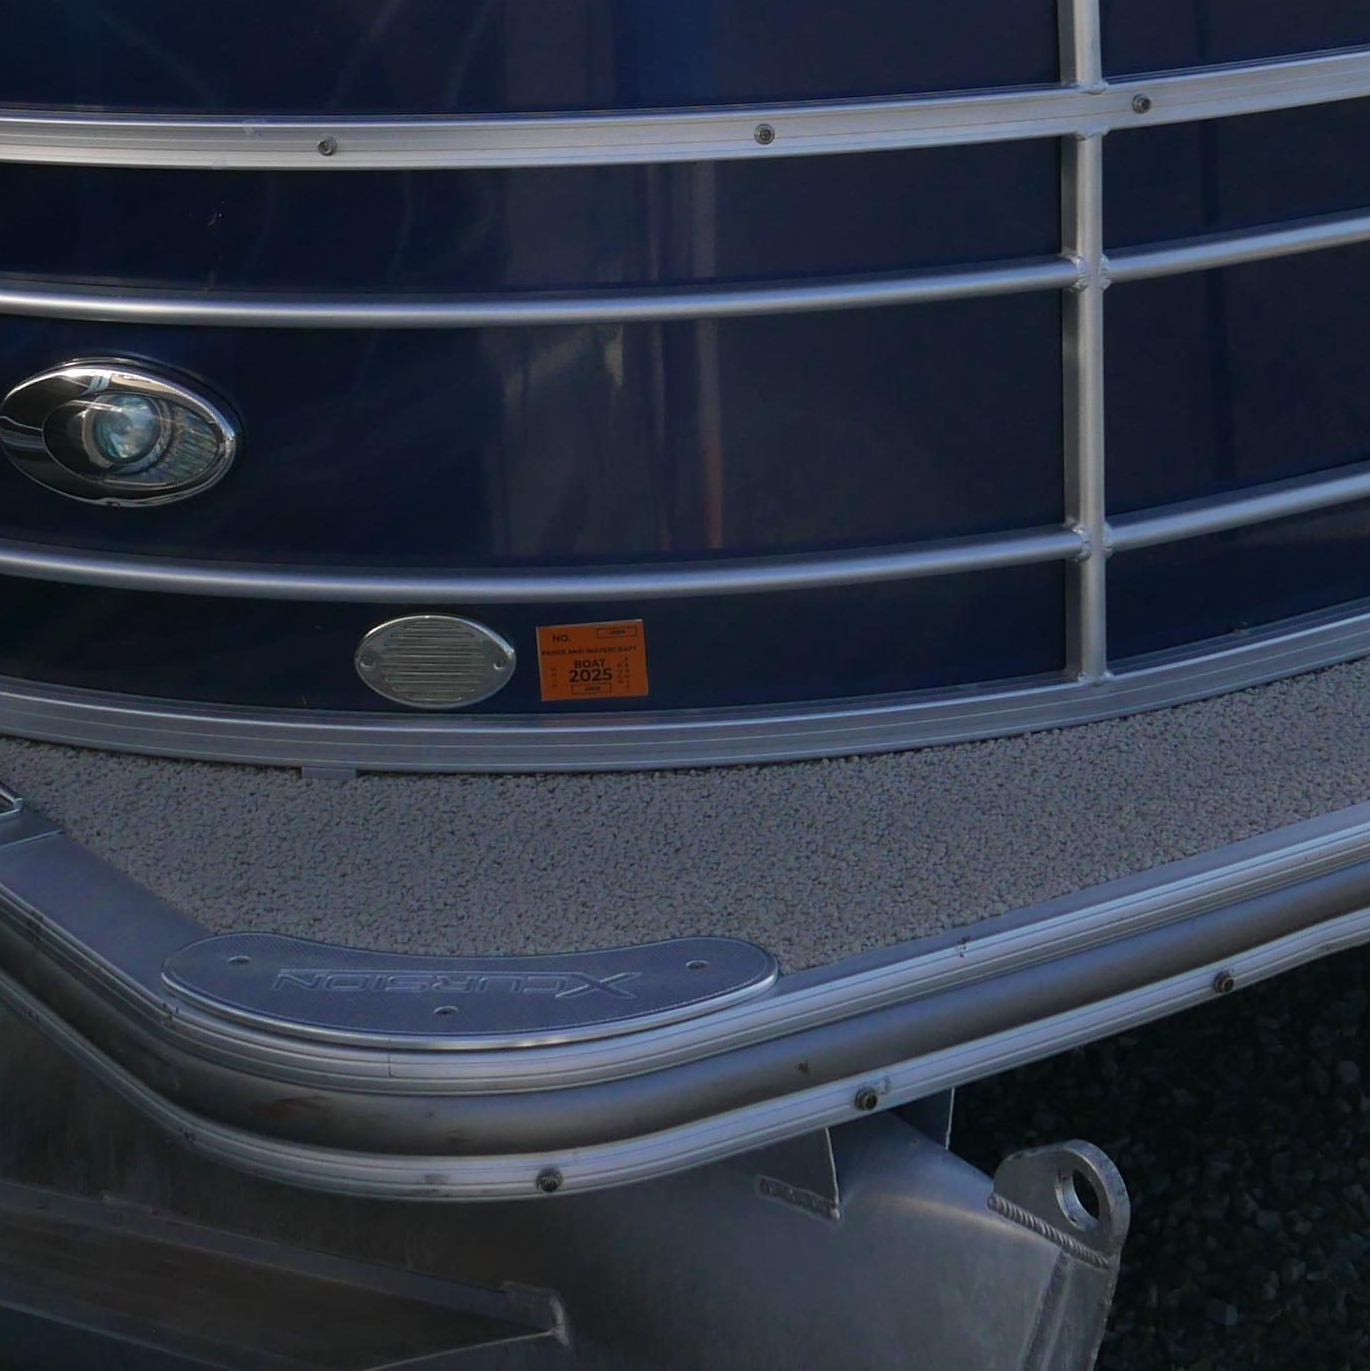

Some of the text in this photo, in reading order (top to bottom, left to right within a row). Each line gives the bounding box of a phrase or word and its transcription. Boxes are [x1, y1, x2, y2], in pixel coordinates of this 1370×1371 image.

[574, 658, 605, 669] BOAT
[569, 668, 613, 683] 2025
[270, 968, 642, 999] XCURSION
